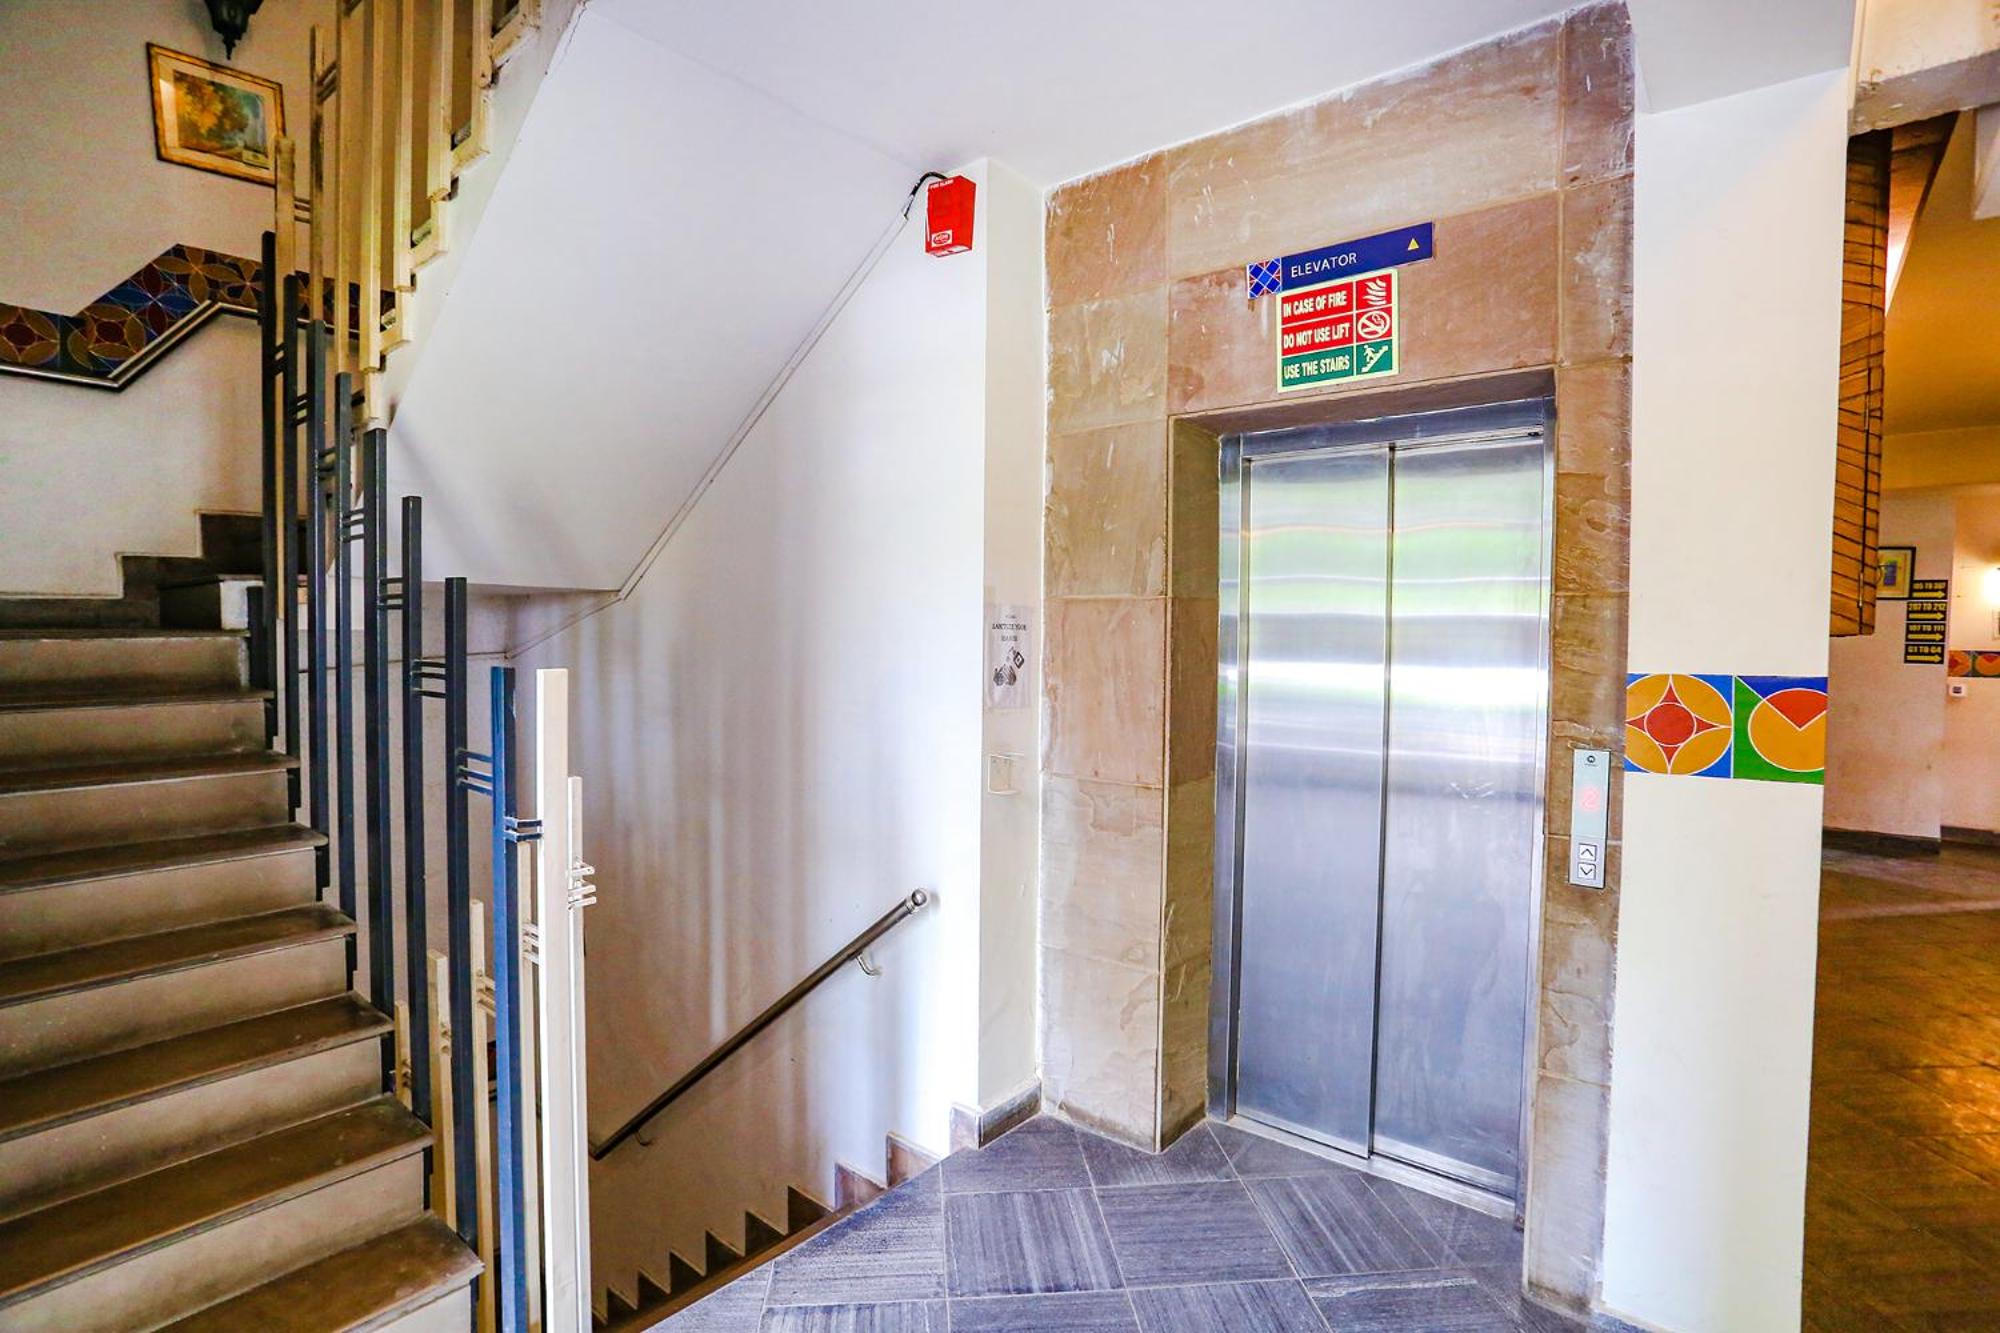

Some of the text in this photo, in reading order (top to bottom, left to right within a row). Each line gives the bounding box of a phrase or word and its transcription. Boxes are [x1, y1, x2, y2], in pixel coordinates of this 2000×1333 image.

[1291, 252, 1357, 278] ELEVATOR
[1283, 290, 1347, 317] IN CASE OF FIRE
[1283, 322, 1351, 349] DO NOT USE LIFT
[1283, 354, 1350, 379] USE THE STAIRS
[1923, 602, 1932, 611] TO
[1922, 624, 1932, 632] TO
[1920, 645, 1929, 653] TO
